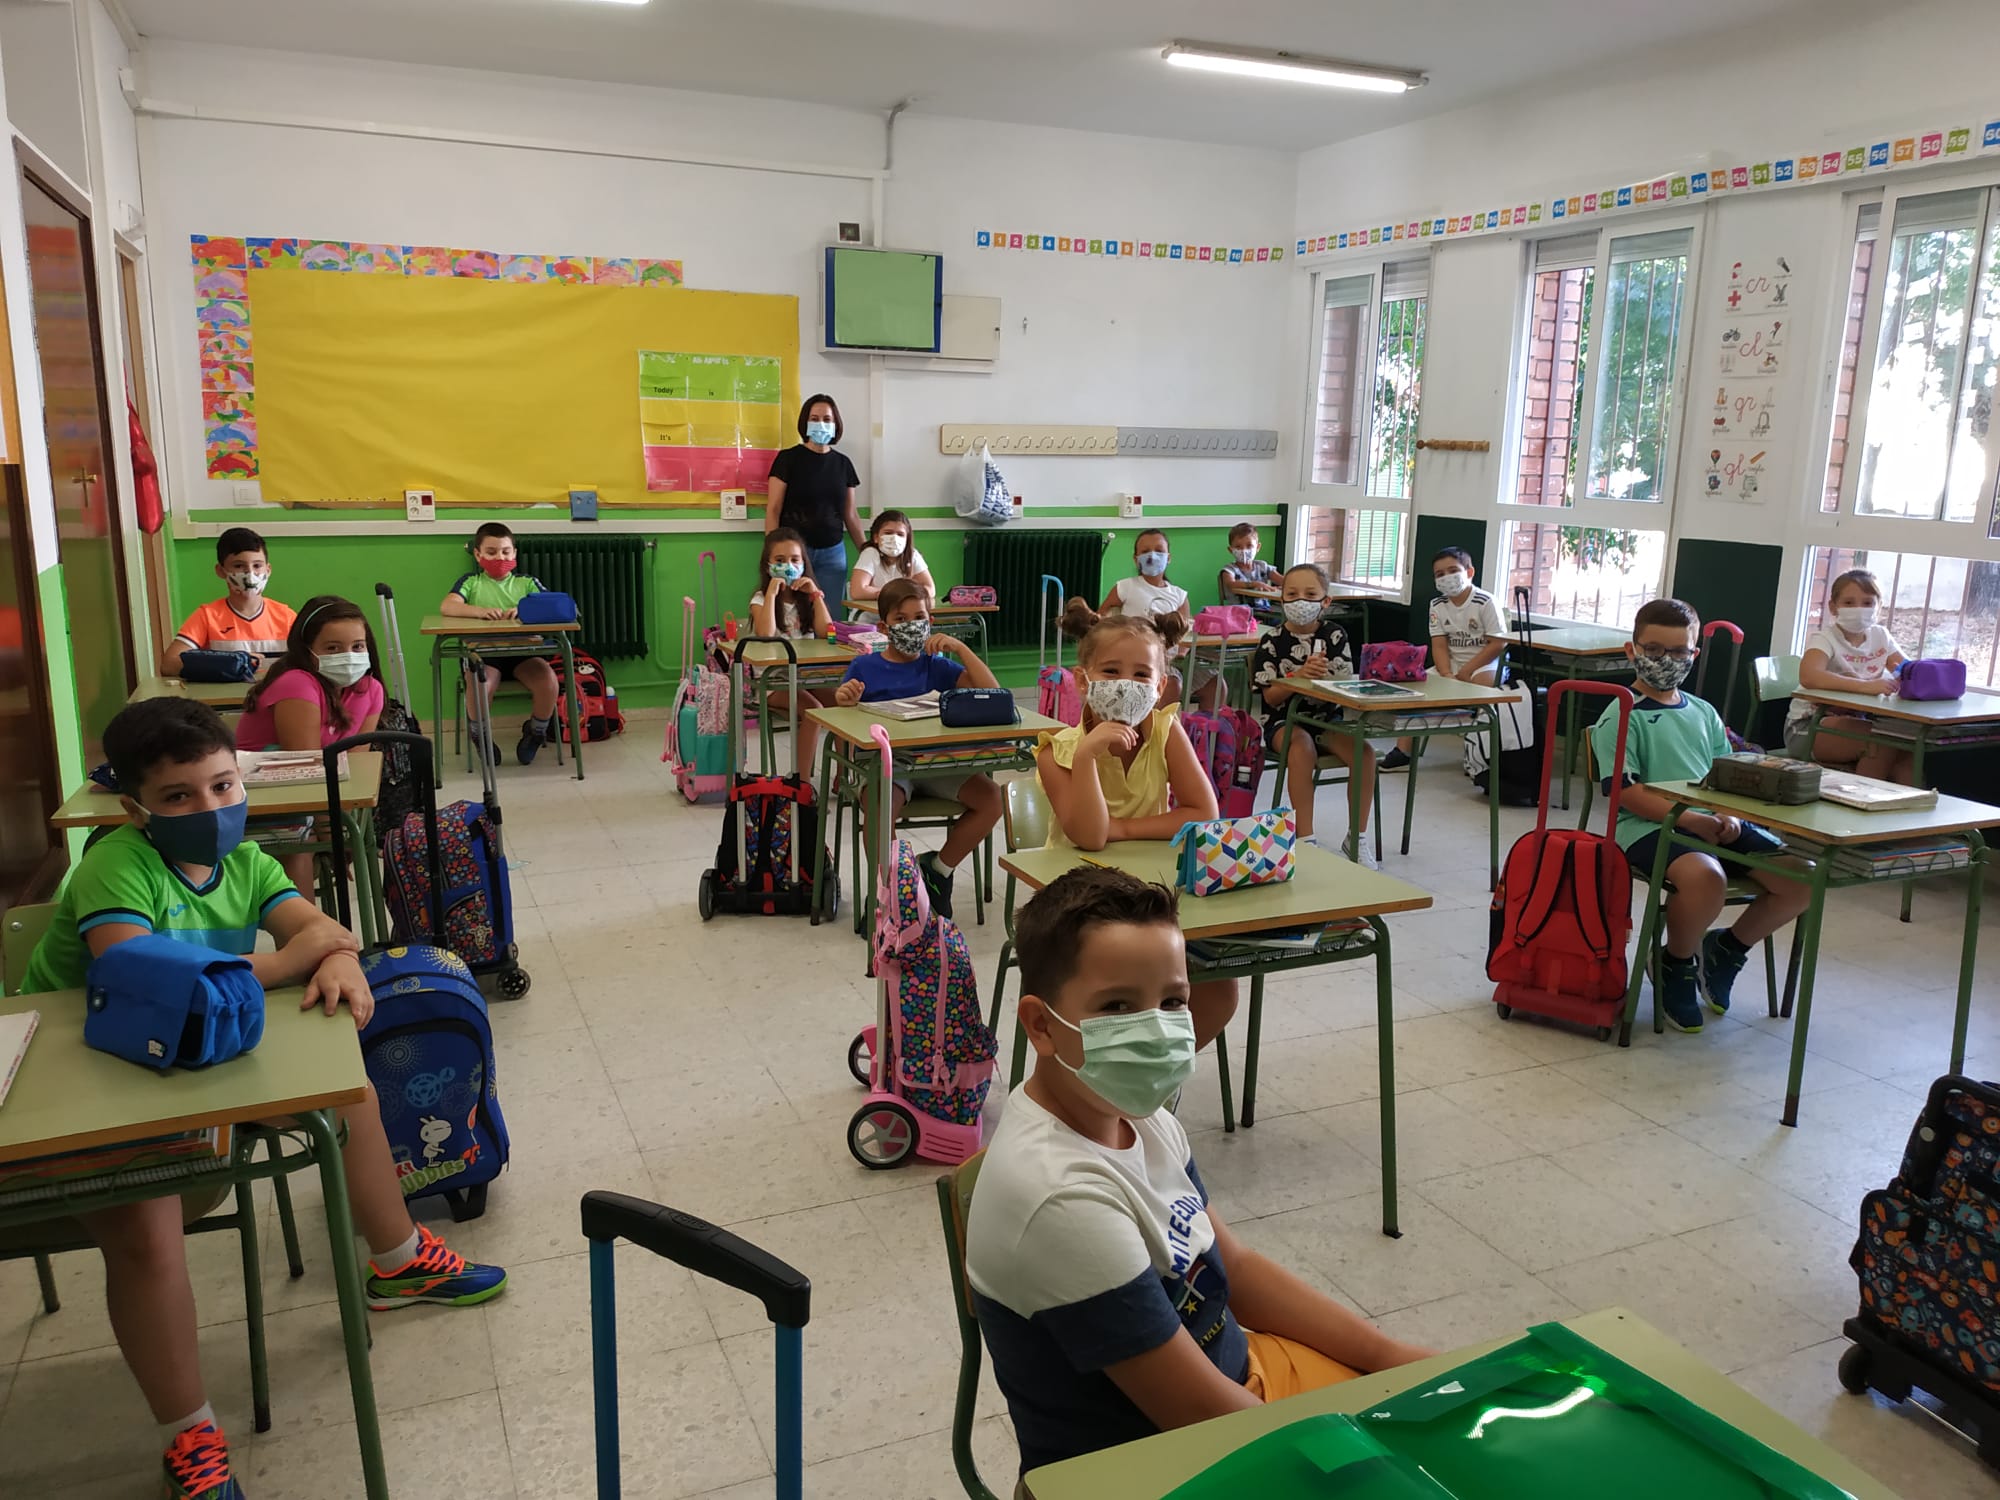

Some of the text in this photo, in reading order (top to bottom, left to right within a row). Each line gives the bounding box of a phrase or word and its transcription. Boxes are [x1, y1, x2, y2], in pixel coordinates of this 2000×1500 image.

[1732, 172, 1746, 183] 50
[1754, 169, 1768, 181] 51
[1775, 165, 1792, 177] 52
[1800, 162, 1817, 174] 53
[1823, 158, 1840, 170] 54
[1847, 153, 1863, 166] 55
[1870, 148, 1888, 161] 56
[1895, 144, 1913, 157] 57
[1921, 139, 1941, 153] 58
[1948, 134, 1968, 148] 59
[653, 386, 674, 396] Today
[1724, 453, 1746, 486] gl
[400, 1160, 466, 1196] UDDIES
